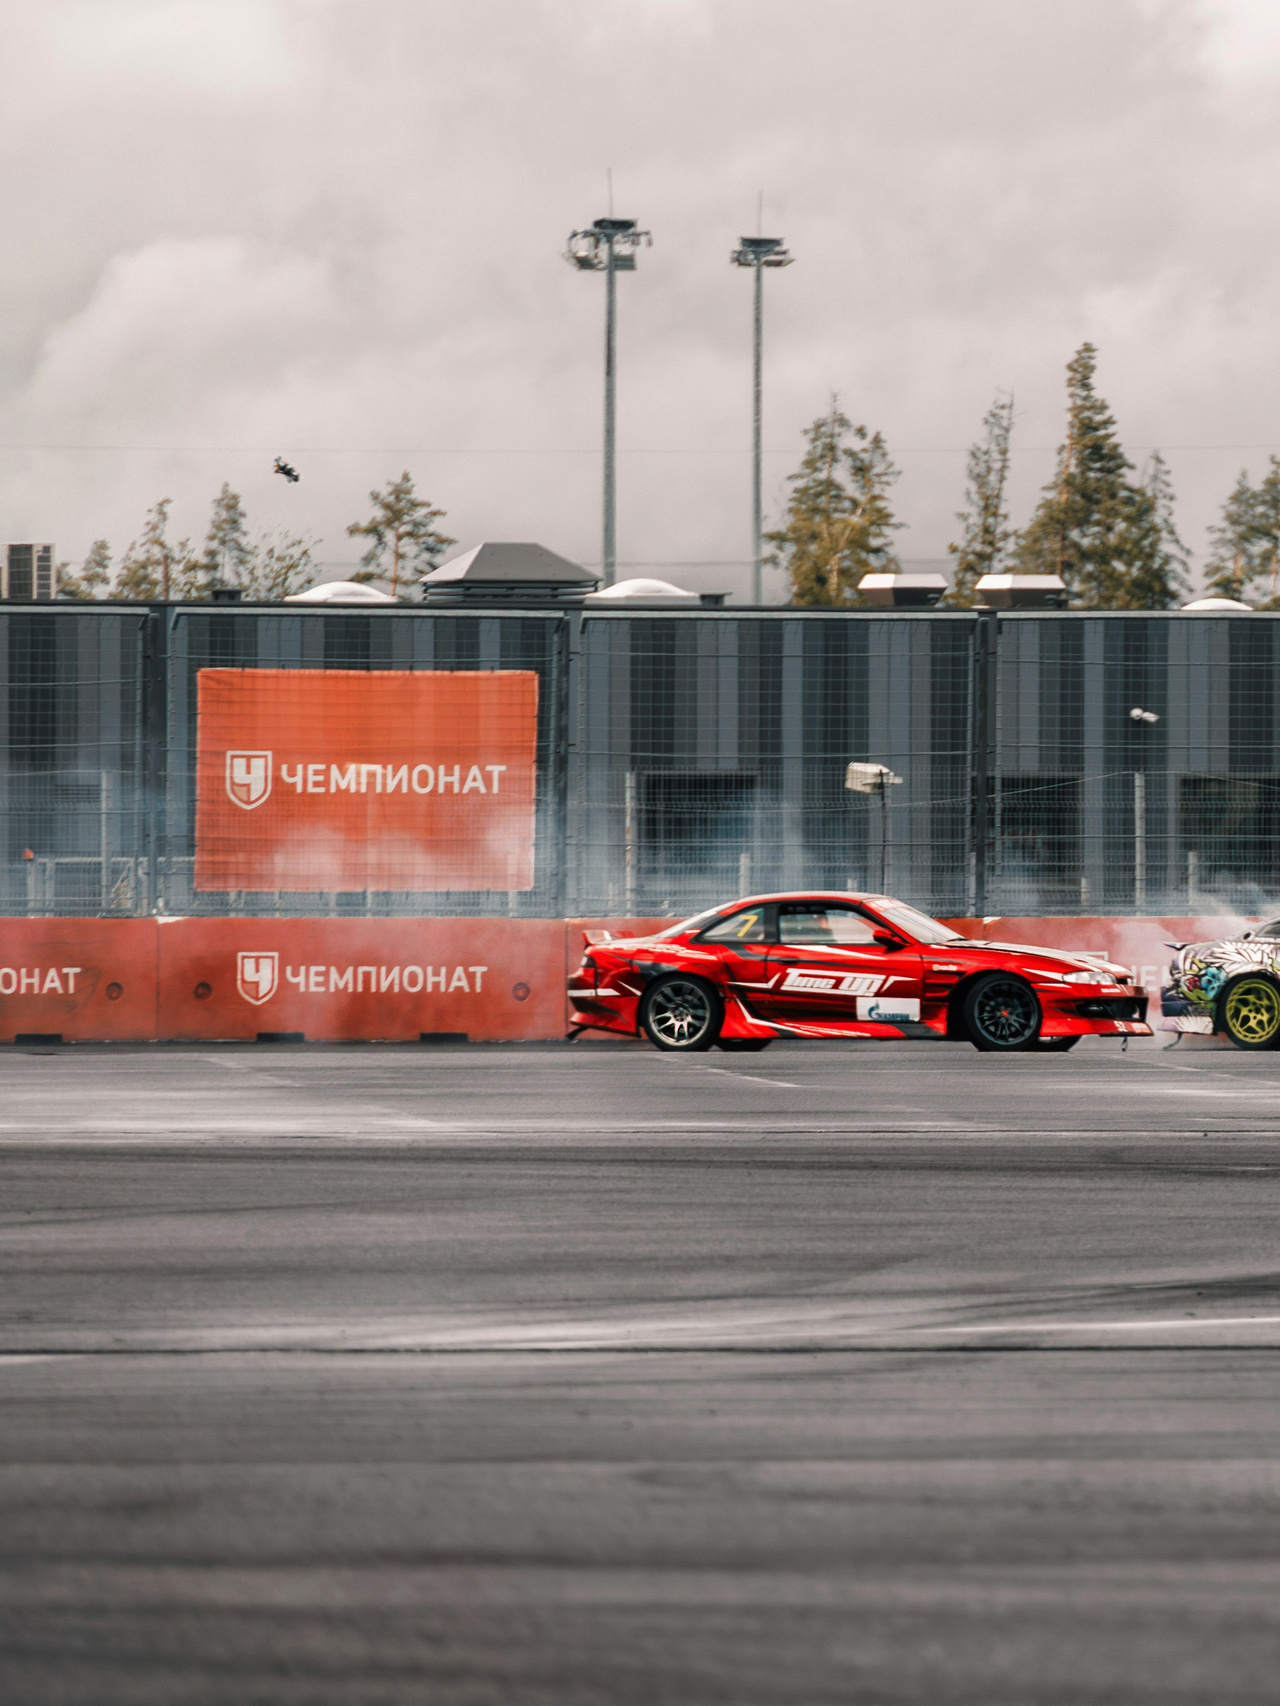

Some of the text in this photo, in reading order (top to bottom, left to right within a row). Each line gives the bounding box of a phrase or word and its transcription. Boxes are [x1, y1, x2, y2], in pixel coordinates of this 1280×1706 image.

[280, 763, 507, 794] ЧЕМПИОНАТ
[736, 914, 759, 938] 7
[0, 966, 82, 995] ОНАТ
[285, 964, 488, 993] ЧЕМПИОНАТ
